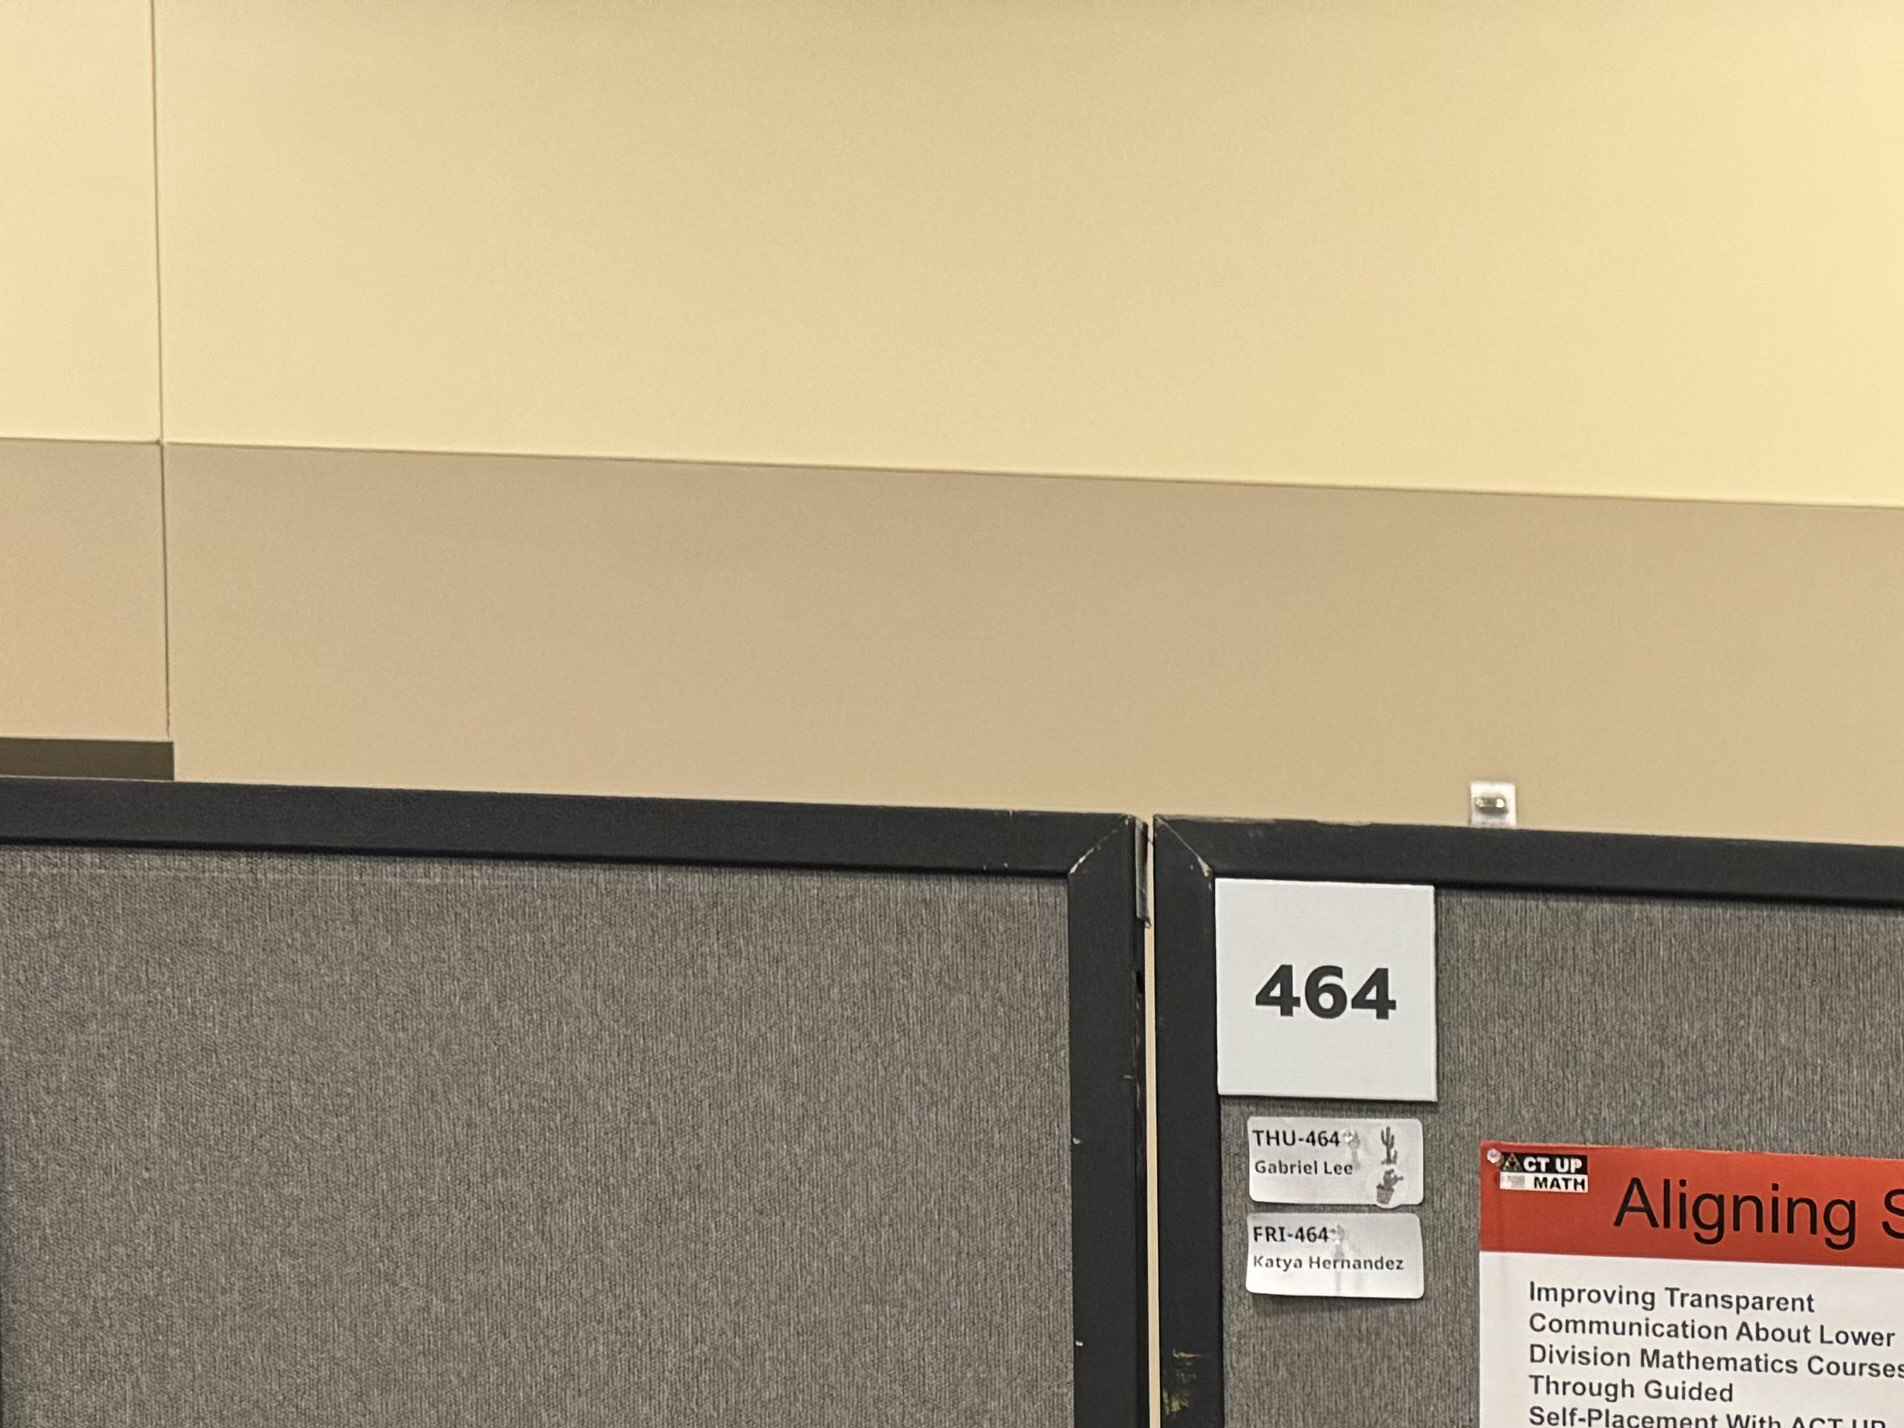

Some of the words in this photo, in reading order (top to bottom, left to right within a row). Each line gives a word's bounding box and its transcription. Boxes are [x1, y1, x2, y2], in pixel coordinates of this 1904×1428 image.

[1256, 964, 1396, 1020] 464
[1252, 1130, 1340, 1147] THU-464
[1255, 1160, 1317, 1174] Gabriel
[1324, 1161, 1352, 1175] Lee
[1555, 1158, 1583, 1173] UP
[1533, 1176, 1586, 1191] MATH
[1614, 1178, 1856, 1250] Aligning
[1254, 1226, 1329, 1242] FRI-464
[1254, 1256, 1302, 1272] Katya
[1309, 1254, 1404, 1270] Hernandez
[1530, 1281, 1655, 1311] Improving
[1664, 1287, 1814, 1315] Transparent
[1530, 1313, 1727, 1340] Communication
[1736, 1321, 1811, 1344] About
[1820, 1324, 1895, 1347] Lower
[1530, 1344, 1630, 1367] Division
[1641, 1348, 1798, 1374] Mathematics
[1528, 1375, 1634, 1402] Through
[1644, 1380, 1732, 1402] Guided
